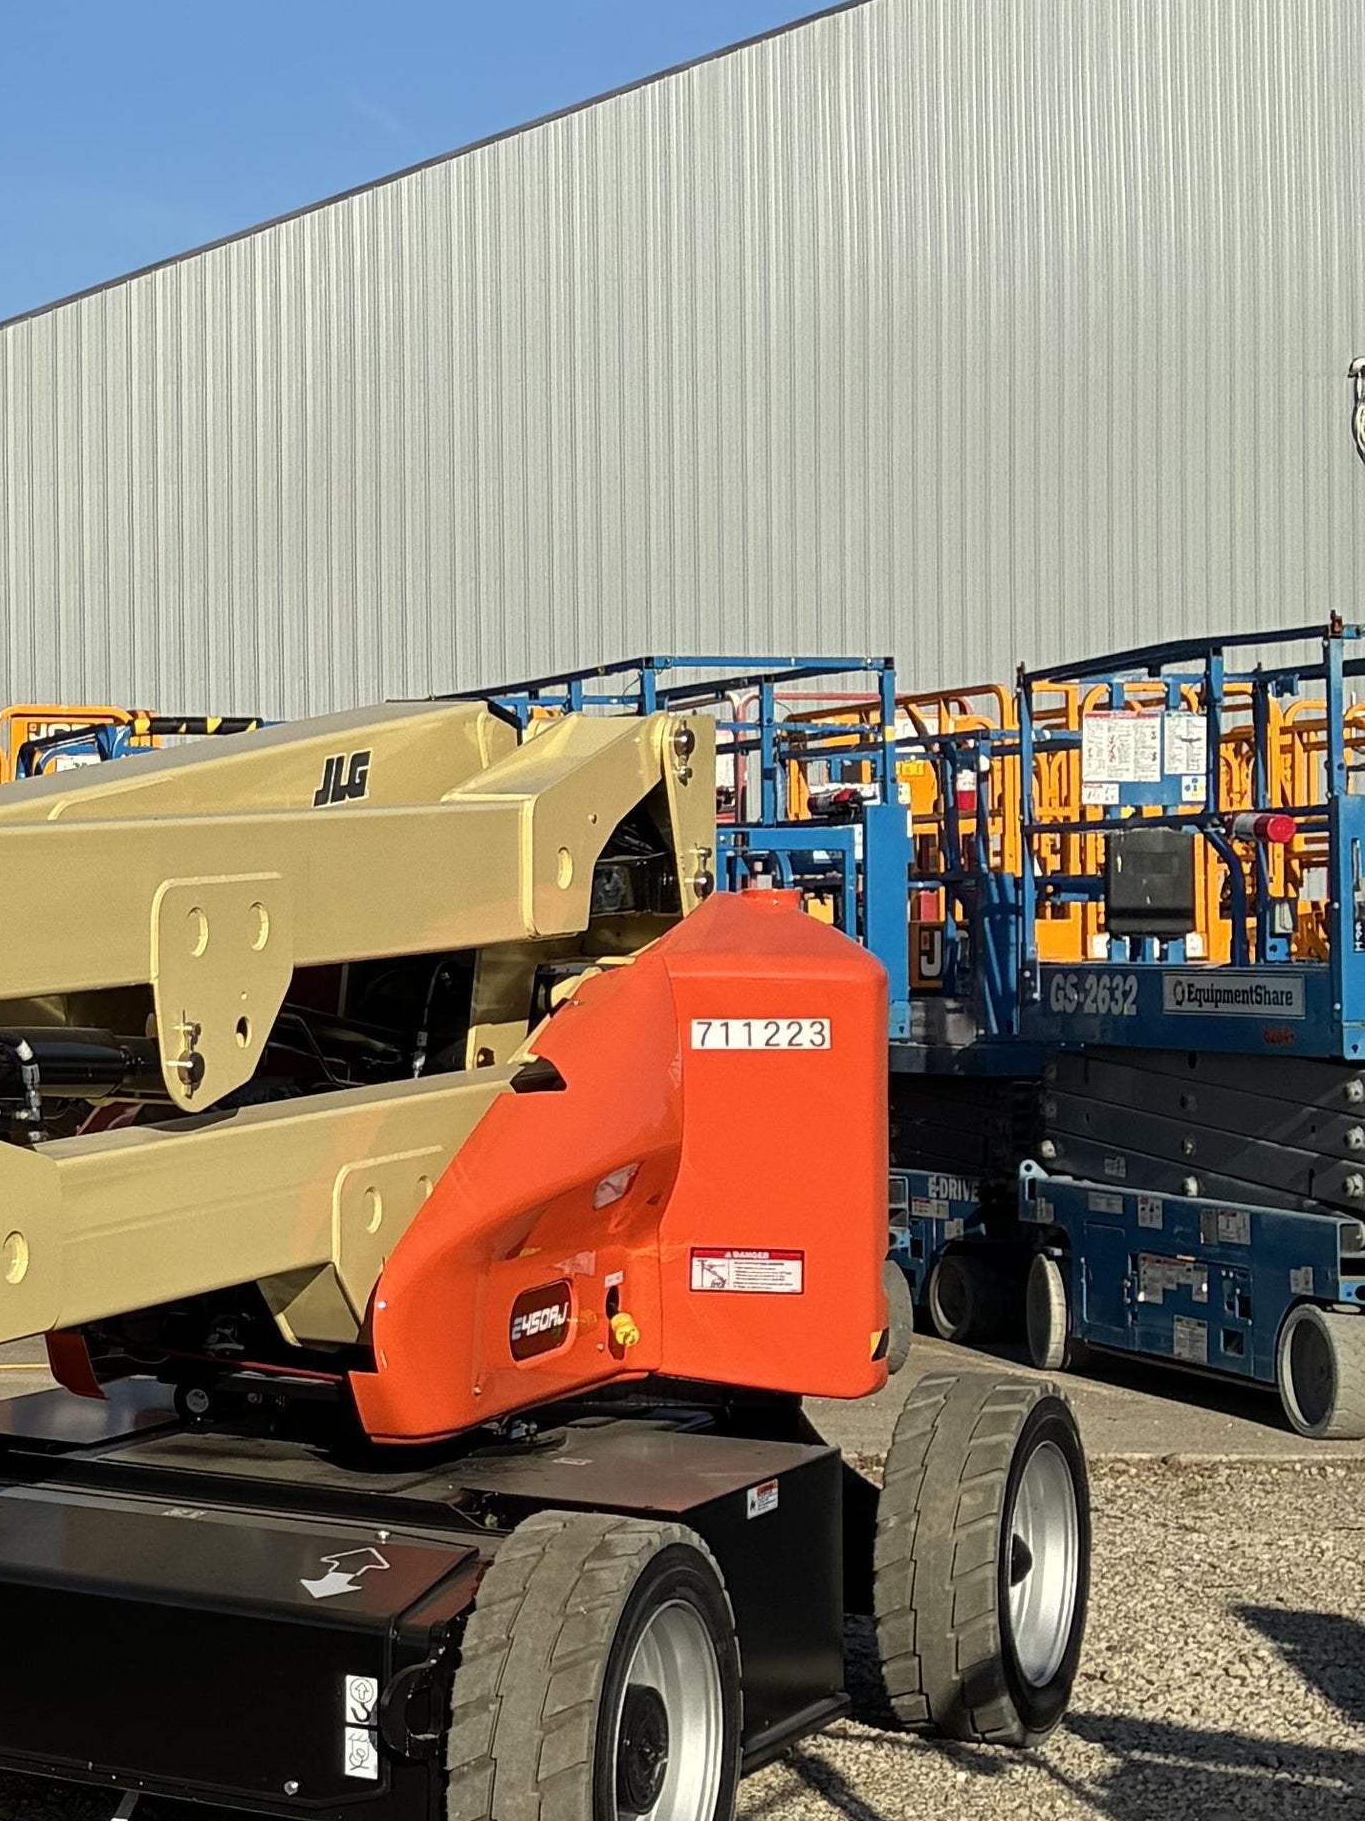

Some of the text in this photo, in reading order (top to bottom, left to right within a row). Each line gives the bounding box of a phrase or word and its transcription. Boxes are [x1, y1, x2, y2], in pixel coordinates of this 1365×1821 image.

[312, 748, 372, 808] JLG
[1050, 973, 1138, 1015] GS-2632
[1186, 983, 1293, 1007] EquipmentShare
[697, 1021, 826, 1047] 711223
[928, 1175, 980, 1203] E-DRIVE
[511, 1302, 569, 1341] E450AJ
